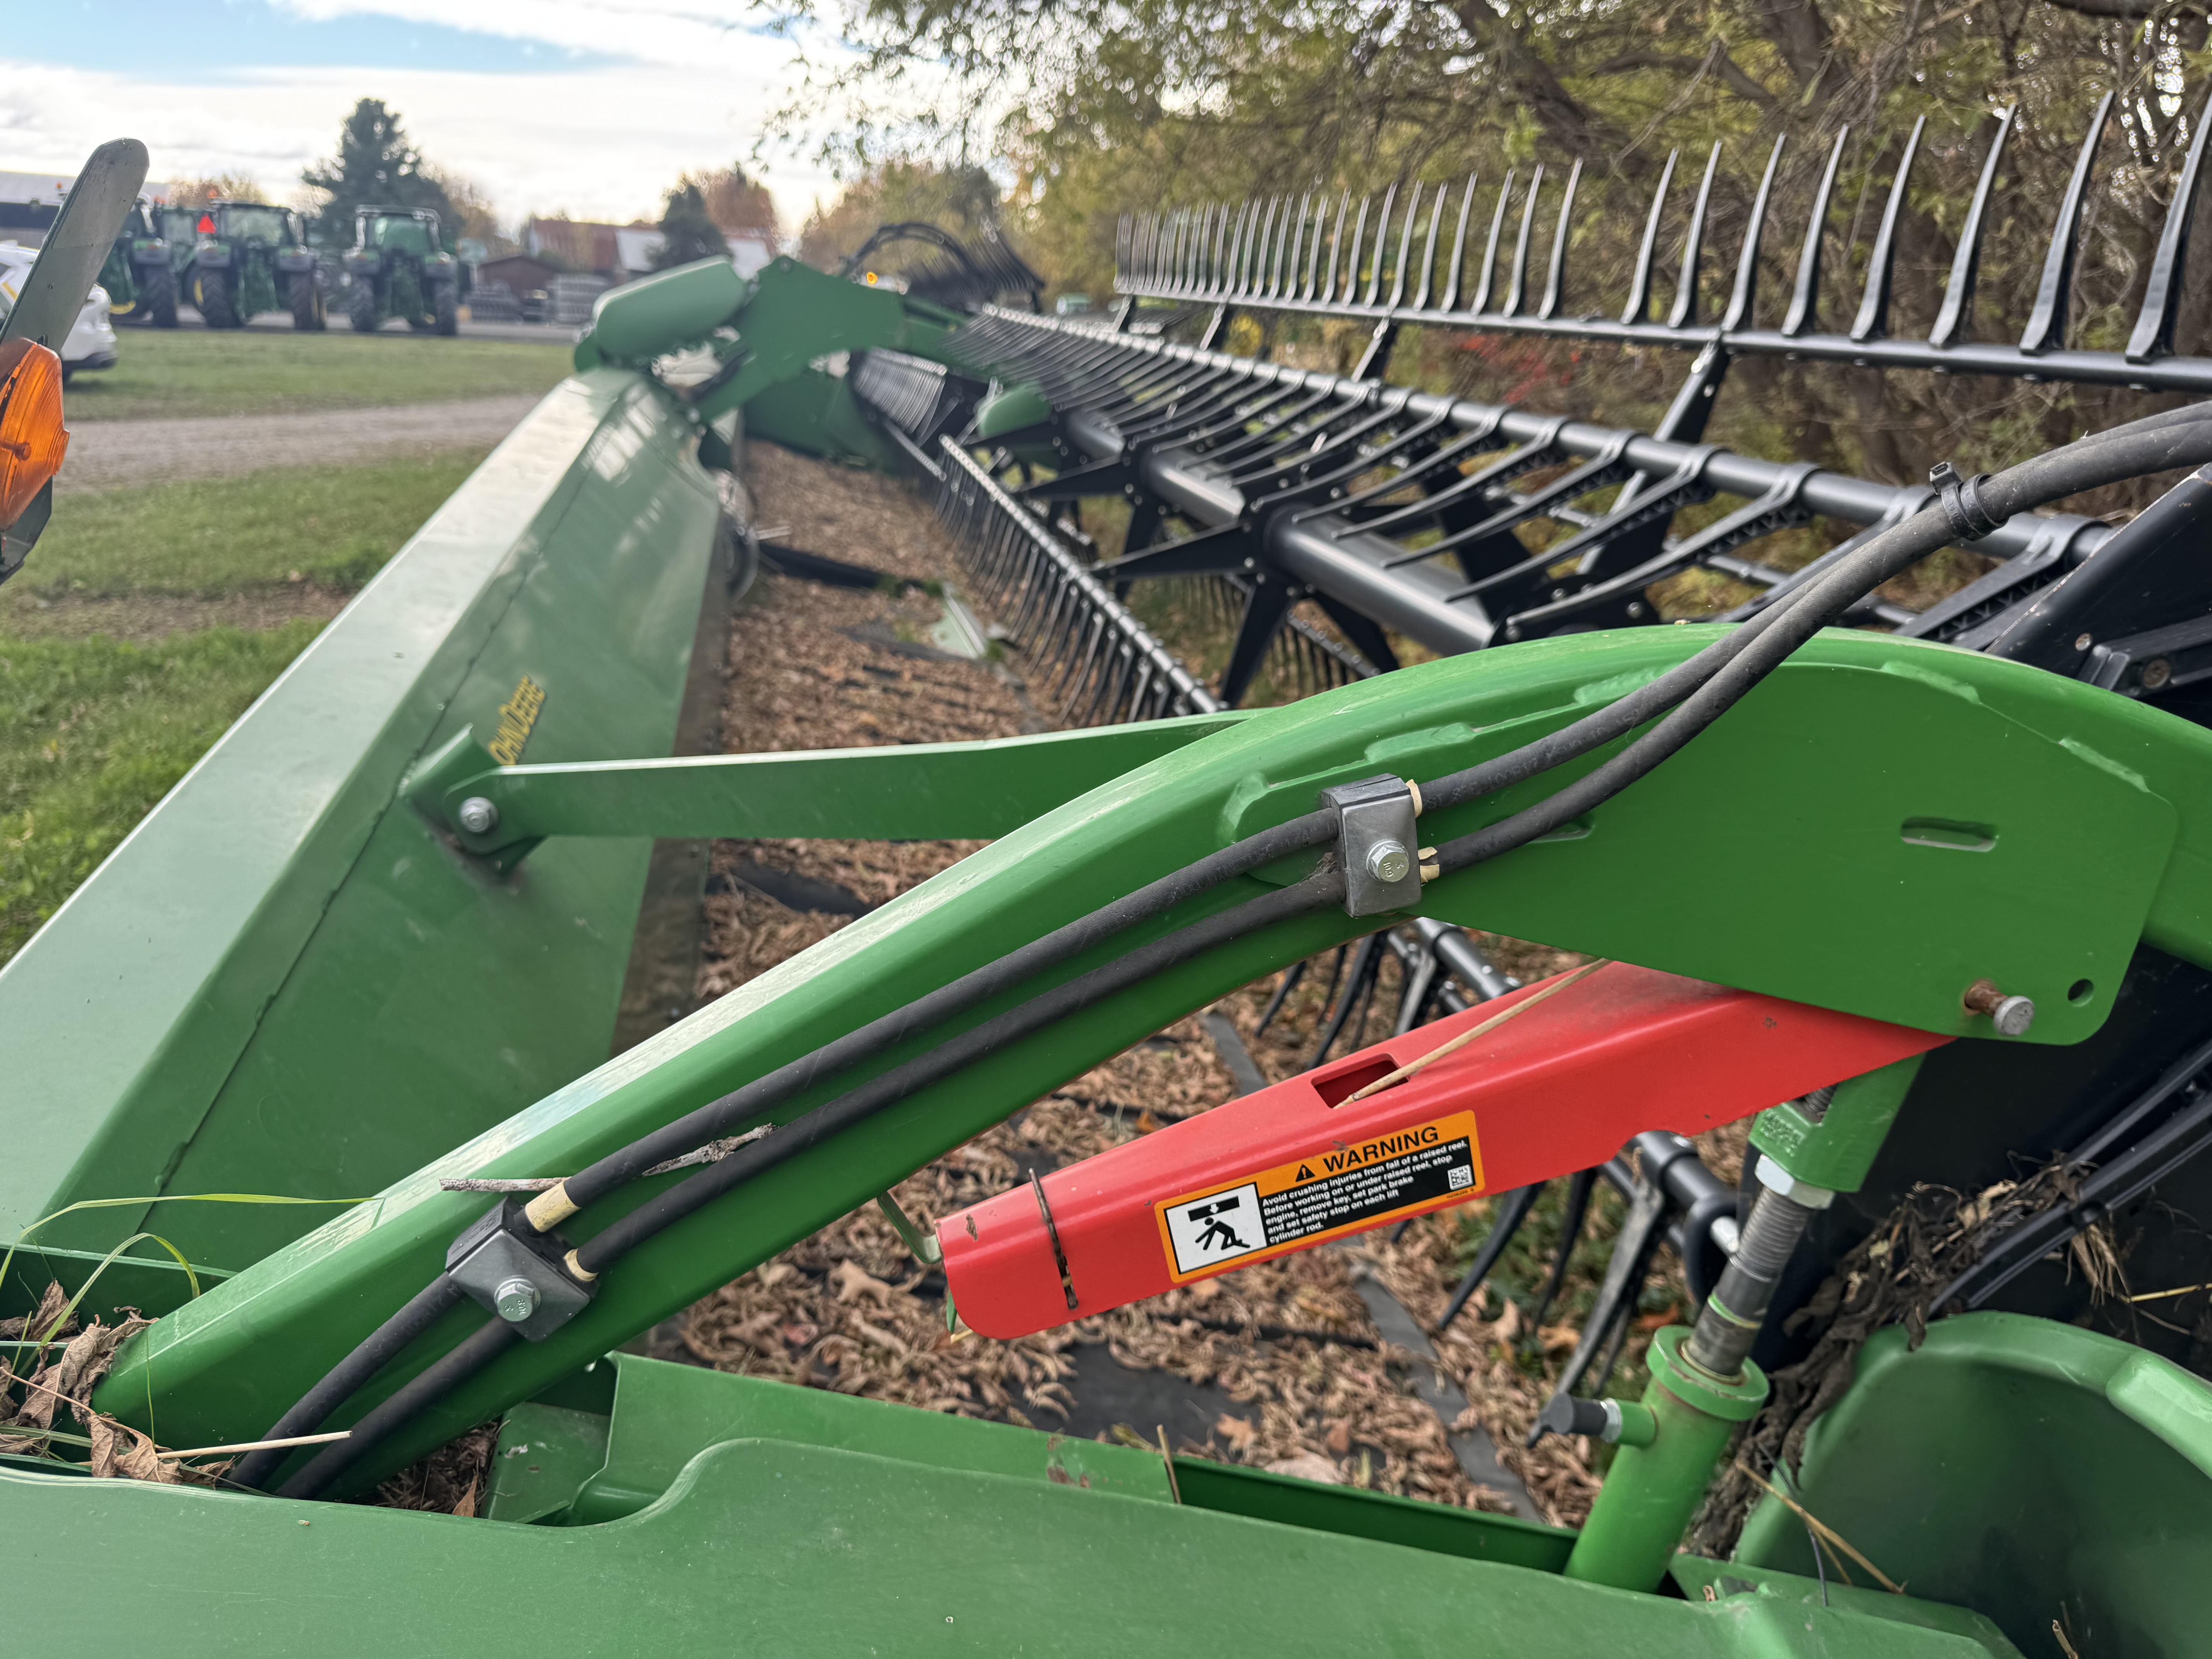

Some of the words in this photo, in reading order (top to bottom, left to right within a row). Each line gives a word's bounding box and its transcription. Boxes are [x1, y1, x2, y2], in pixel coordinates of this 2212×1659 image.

[1323, 1127, 1438, 1172] WARNING
[1263, 1193, 1287, 1207] Avoid
[1289, 1182, 1328, 1199] crushing
[1329, 1172, 1362, 1187] injuries
[1364, 1166, 1384, 1176] from
[1386, 1159, 1400, 1170] fall
[1401, 1156, 1410, 1165] of
[1420, 1146, 1447, 1159] raised
[1264, 1203, 1293, 1216] Before
[1295, 1189, 1330, 1207] working
[1357, 1176, 1381, 1188] under
[1384, 1166, 1411, 1180] raised
[1433, 1155, 1452, 1166] stop
[1300, 1201, 1332, 1215] remove
[1353, 1189, 1366, 1199] set
[1368, 1183, 1389, 1196] park
[1389, 1176, 1413, 1189] brake
[1268, 1222, 1284, 1234] and
[1286, 1219, 1300, 1228] set
[1302, 1211, 1328, 1226] safety
[1330, 1205, 1349, 1216] stop
[1351, 1201, 1363, 1209] on
[1364, 1194, 1385, 1205] each
[1387, 1189, 1399, 1198] lift
[1270, 1228, 1306, 1244] cylinder
